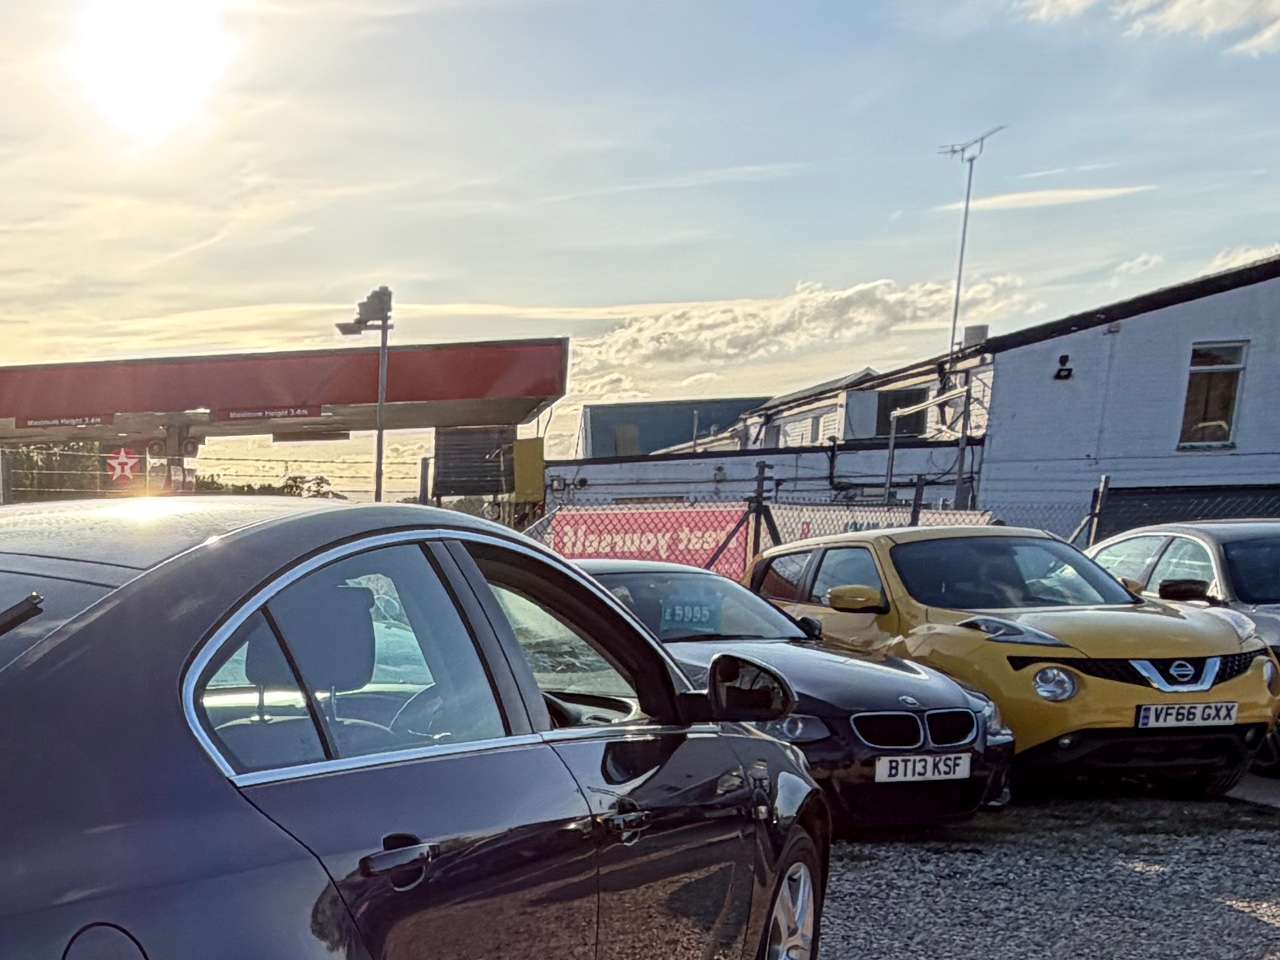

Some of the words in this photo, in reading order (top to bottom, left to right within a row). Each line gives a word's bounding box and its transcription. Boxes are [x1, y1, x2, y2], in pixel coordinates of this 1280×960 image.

[1154, 706, 1197, 722] VF66
[1201, 704, 1236, 721] GXX
[888, 759, 928, 778] BT13
[932, 756, 962, 776] KSF
